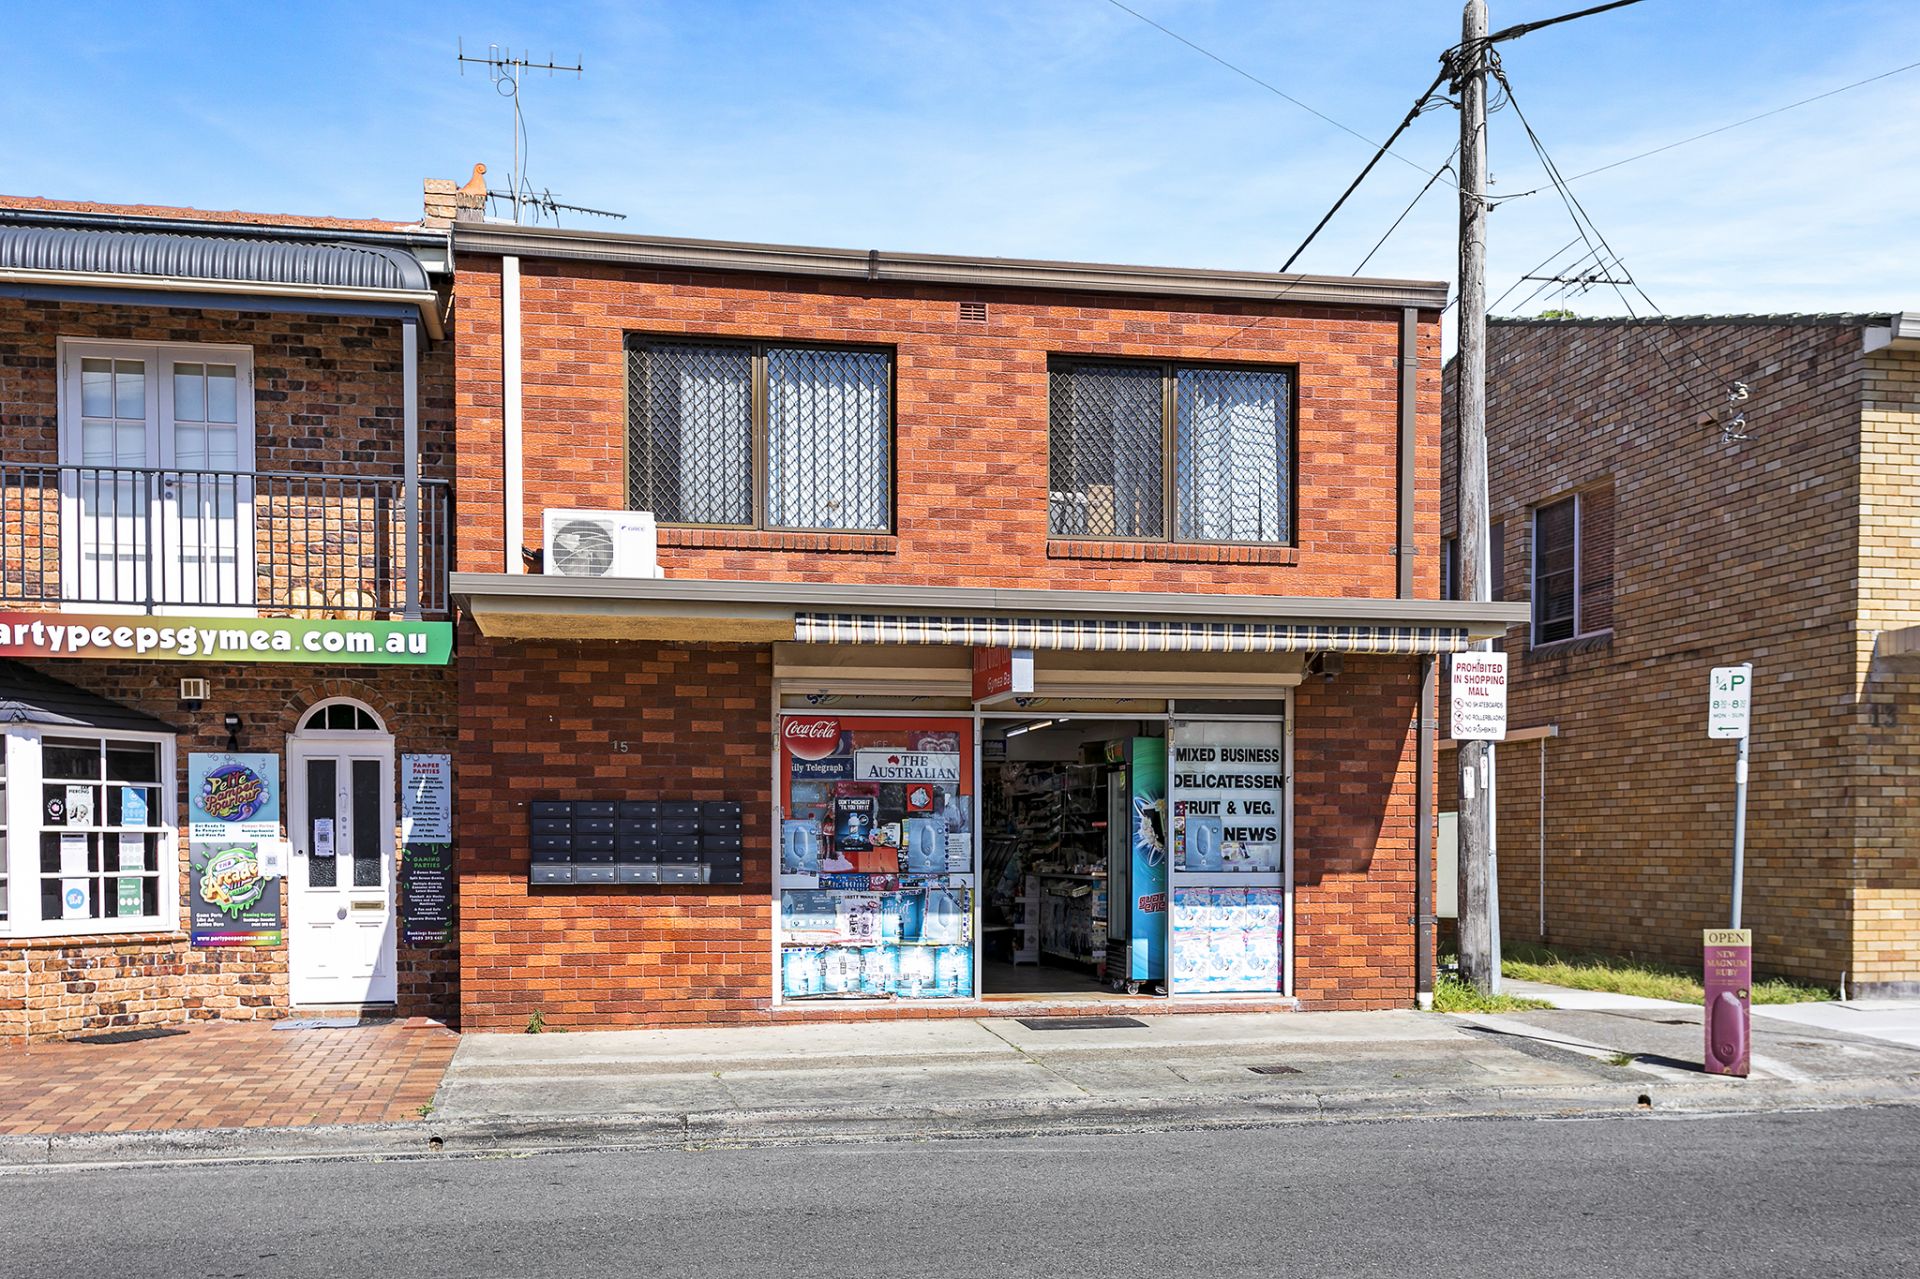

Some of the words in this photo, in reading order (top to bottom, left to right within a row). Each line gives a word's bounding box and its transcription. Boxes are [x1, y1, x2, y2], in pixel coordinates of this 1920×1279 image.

[1456, 663, 1502, 673] PROHIBITED
[1454, 675, 1462, 684] IN
[1464, 675, 1504, 685] SHOPPING
[1731, 675, 1745, 691] P
[1468, 687, 1489, 696] MALL
[785, 720, 838, 738] Coca-Cola
[612, 740, 628, 752] 15
[901, 756, 928, 767] THE
[1176, 748, 1216, 762] MIXED
[1221, 748, 1279, 762] BUSINESS
[806, 764, 844, 773] Telegraph
[868, 765, 956, 779] AUSTRALIAN
[1174, 774, 1283, 788] DELICATESSEN
[1227, 800, 1236, 814] &
[1243, 801, 1275, 814] VEG.
[1224, 827, 1276, 841] NEWS
[1709, 932, 1745, 944] OPEN
